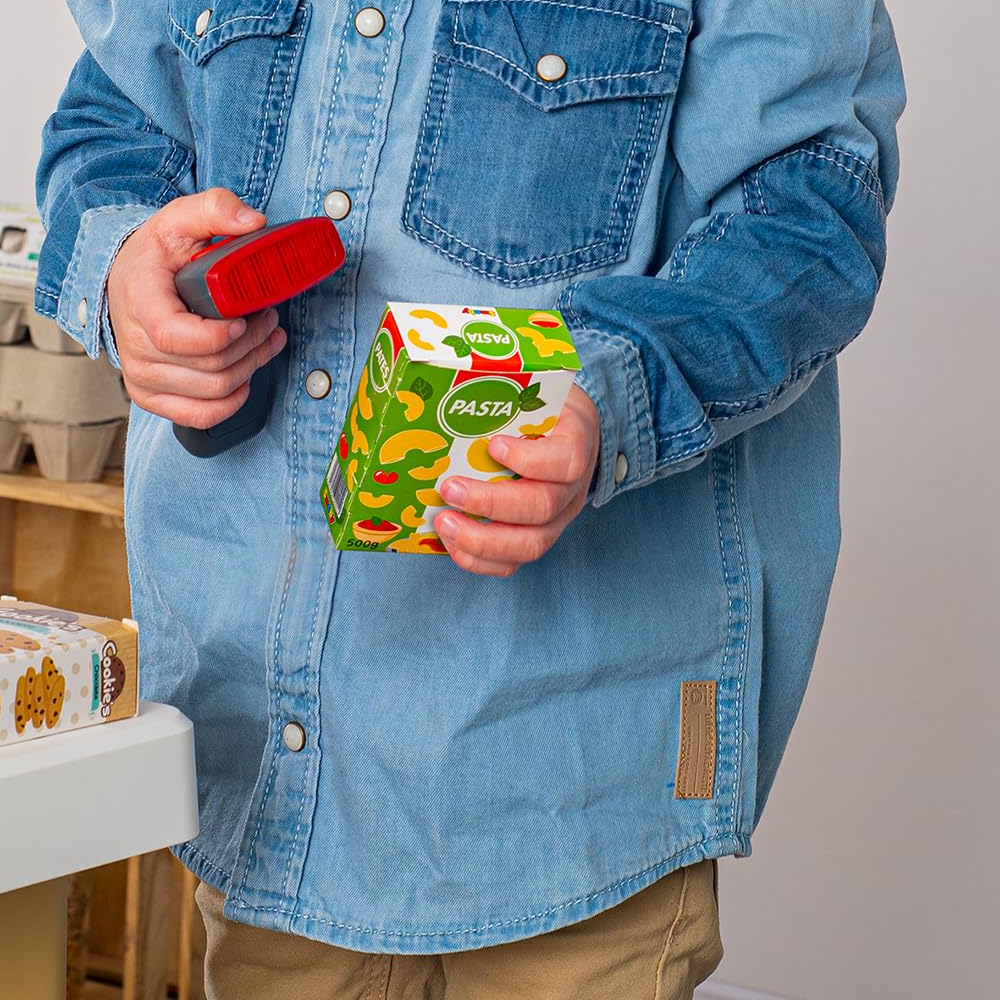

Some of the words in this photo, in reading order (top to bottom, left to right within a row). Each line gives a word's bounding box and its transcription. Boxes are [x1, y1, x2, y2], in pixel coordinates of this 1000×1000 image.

[466, 332, 510, 345] PASTA
[448, 399, 513, 418] PASTA
[347, 538, 379, 550] 500g
[101, 641, 117, 718] Cookie's
